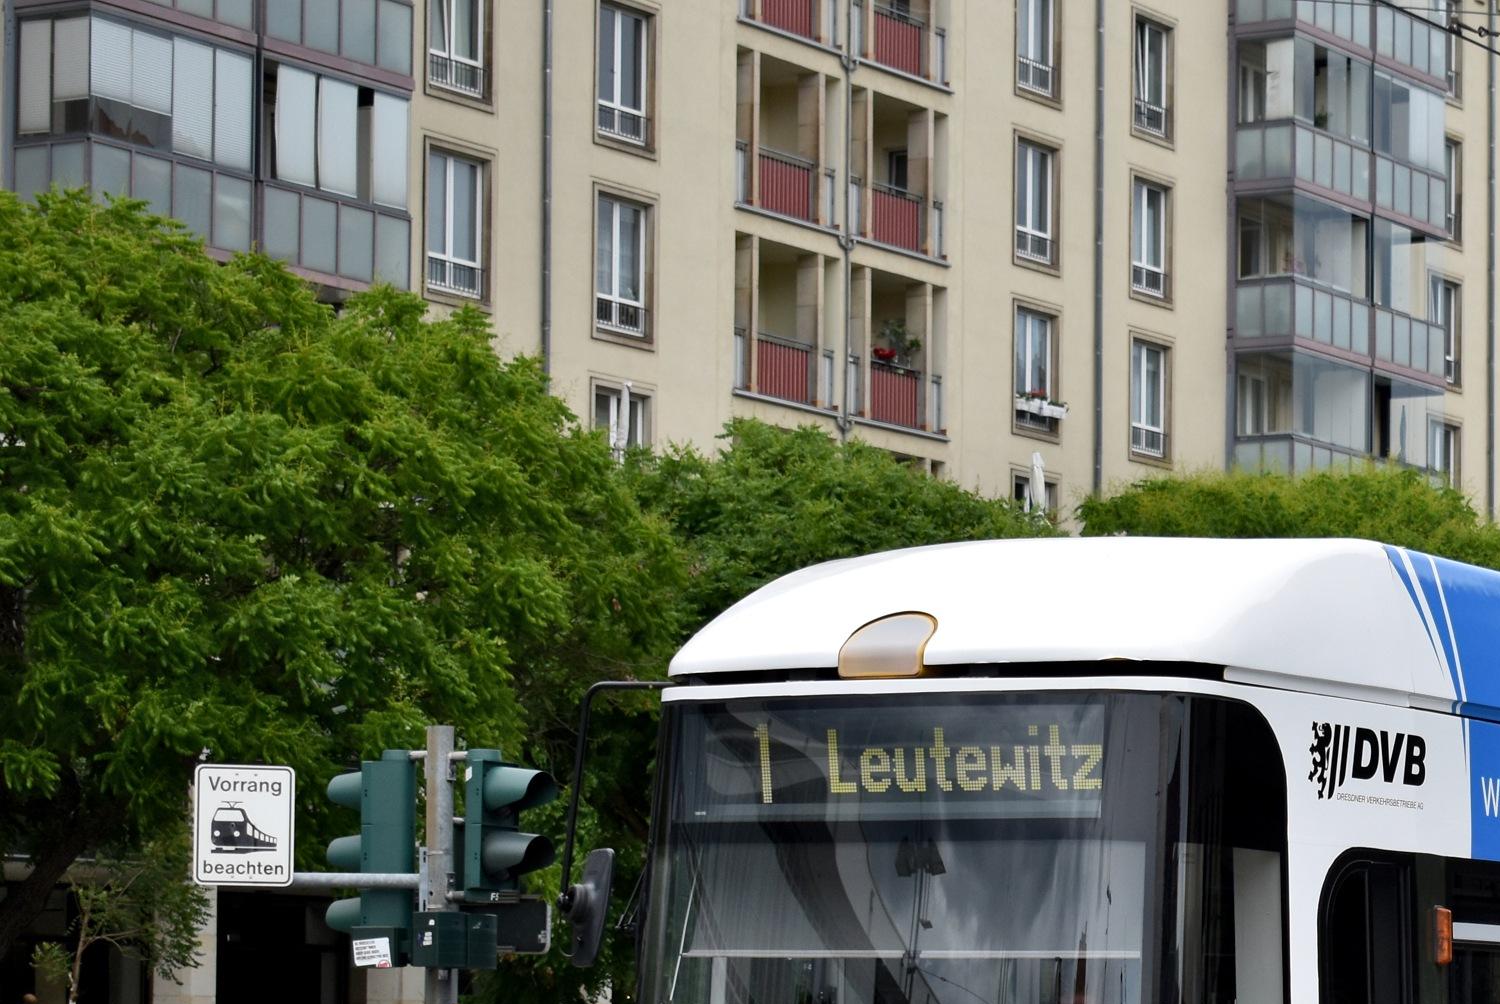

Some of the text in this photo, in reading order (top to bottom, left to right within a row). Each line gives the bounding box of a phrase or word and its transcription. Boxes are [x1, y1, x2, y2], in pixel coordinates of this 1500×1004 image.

[754, 723, 1103, 804] 1 Leutewitz
[1351, 726, 1426, 786] DVB
[208, 776, 283, 797] Vorrang
[1336, 793, 1366, 804] DRESDNER
[202, 860, 285, 876] beachten
